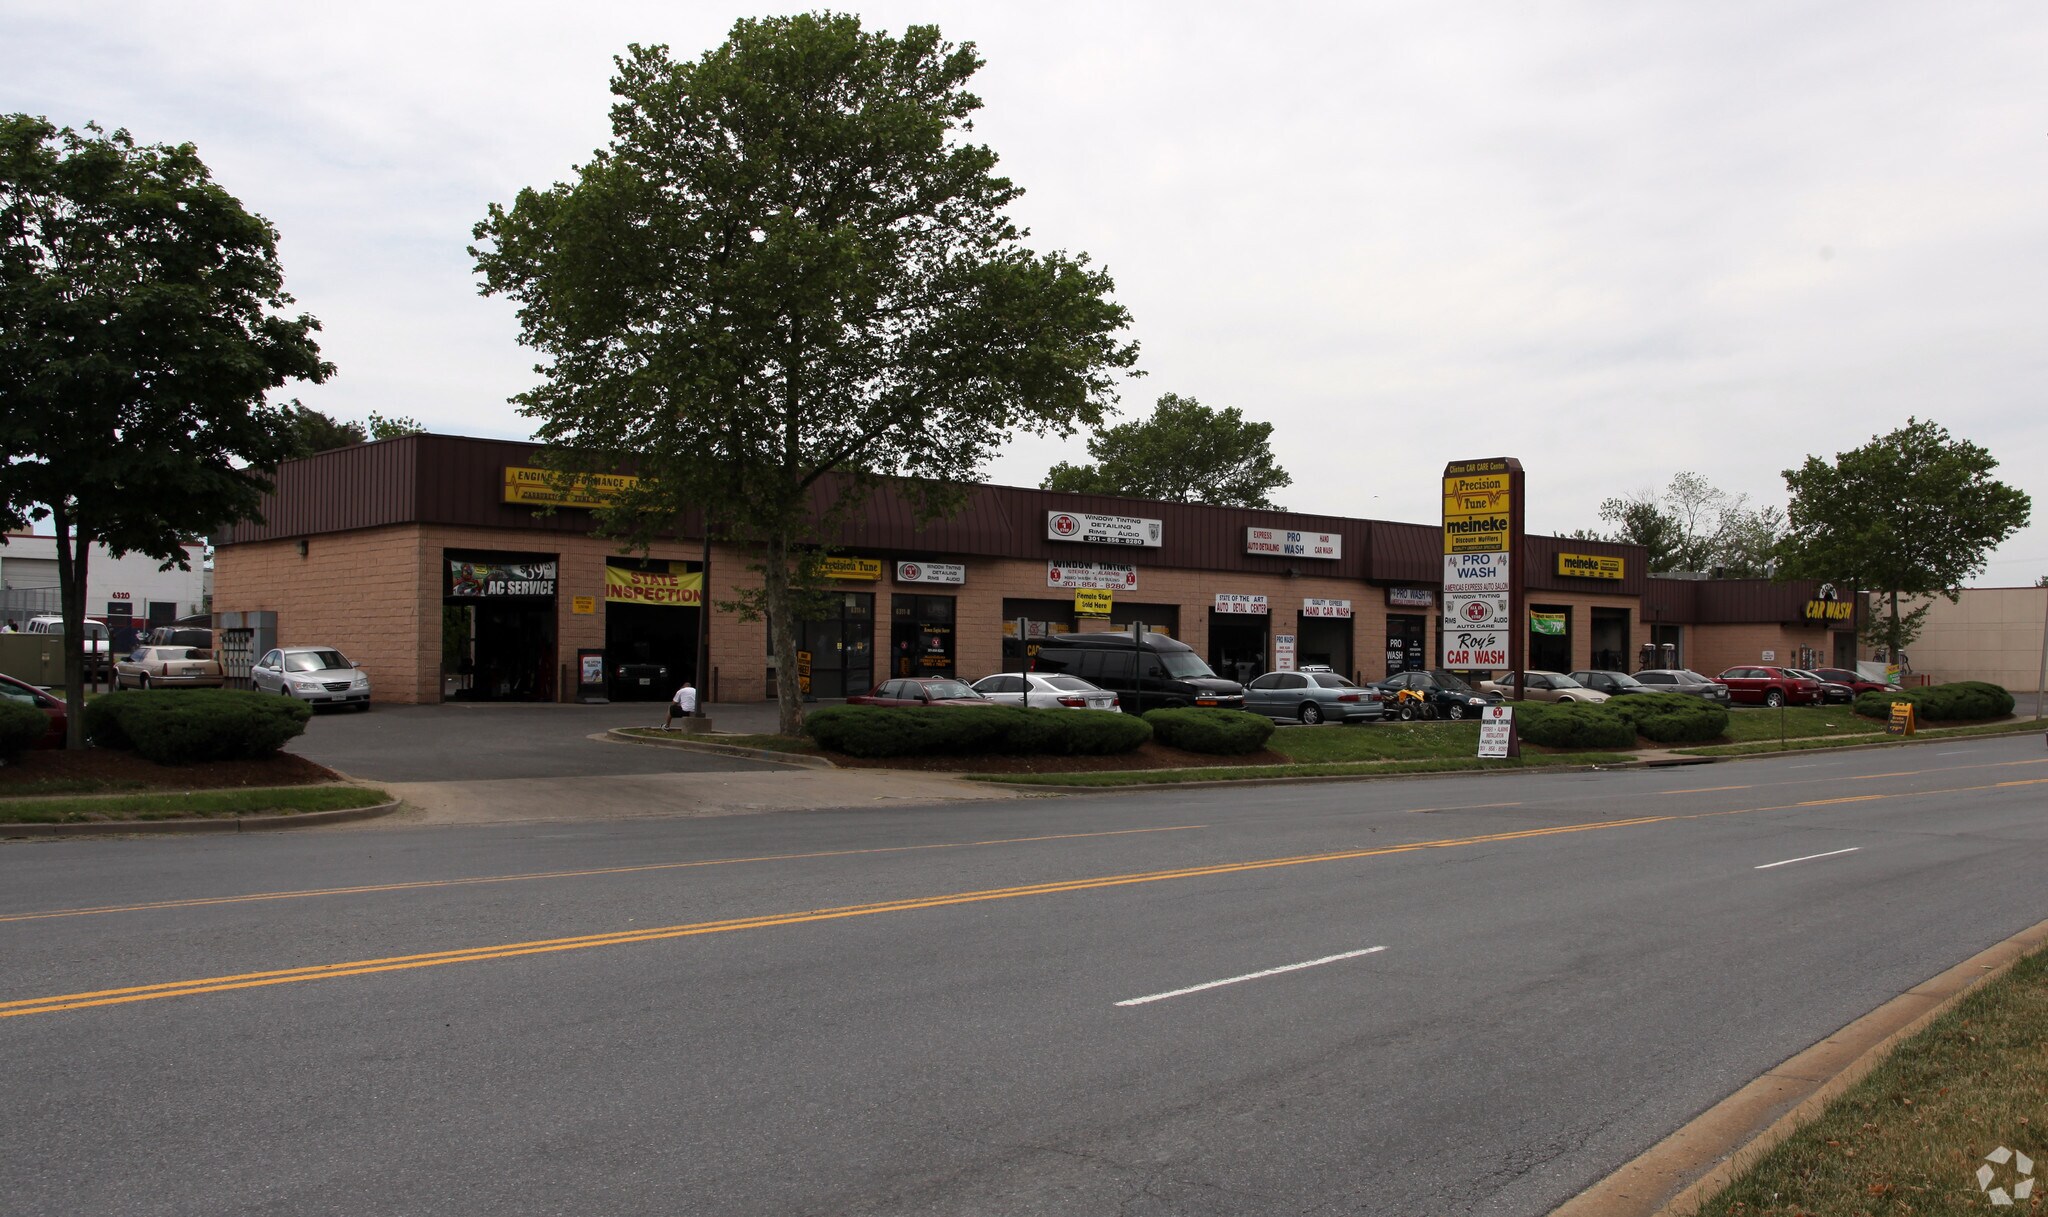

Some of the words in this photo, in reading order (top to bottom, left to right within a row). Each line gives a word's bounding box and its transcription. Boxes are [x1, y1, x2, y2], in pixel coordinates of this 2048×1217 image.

[1466, 464, 1476, 472] CAR
[1477, 462, 1489, 471] CARE
[1490, 462, 1505, 470] Center
[1459, 477, 1501, 491] Precision
[1464, 498, 1487, 510] Tune
[1085, 514, 1113, 522] WINDOW
[1447, 516, 1508, 534] meineke
[1254, 531, 1272, 540] EXPRESS
[1287, 532, 1300, 542] PRO
[1260, 543, 1280, 552] DETAILING
[1284, 544, 1304, 554] WASH
[859, 560, 878, 572] Tune
[1053, 560, 1092, 570] WINDOW
[1100, 564, 1132, 572] TINTING
[1463, 554, 1490, 566] PRO
[1564, 556, 1598, 570] meineke
[1457, 566, 1496, 578] WASH
[630, 572, 678, 586] STATE
[488, 580, 504, 595] AC
[508, 580, 554, 595] SERVICE
[606, 584, 702, 602] INSPECTION
[112, 592, 130, 600] 6320
[1396, 588, 1408, 598] PRO
[1410, 590, 1426, 600] WASH
[1216, 602, 1228, 612] AUTO
[1232, 603, 1247, 613] DETAIL
[1250, 604, 1266, 614] CENTER
[1306, 606, 1320, 616] HAND
[1322, 607, 1334, 616] CAR
[1336, 608, 1350, 616] WASH
[1806, 600, 1826, 619] CAR
[1826, 600, 1852, 620] WASH
[1390, 638, 1402, 648] PRO
[1458, 632, 1496, 650] Roy's
[1386, 651, 1404, 660] WASH
[1447, 650, 1469, 664] CAR
[1474, 650, 1505, 664] WASH
